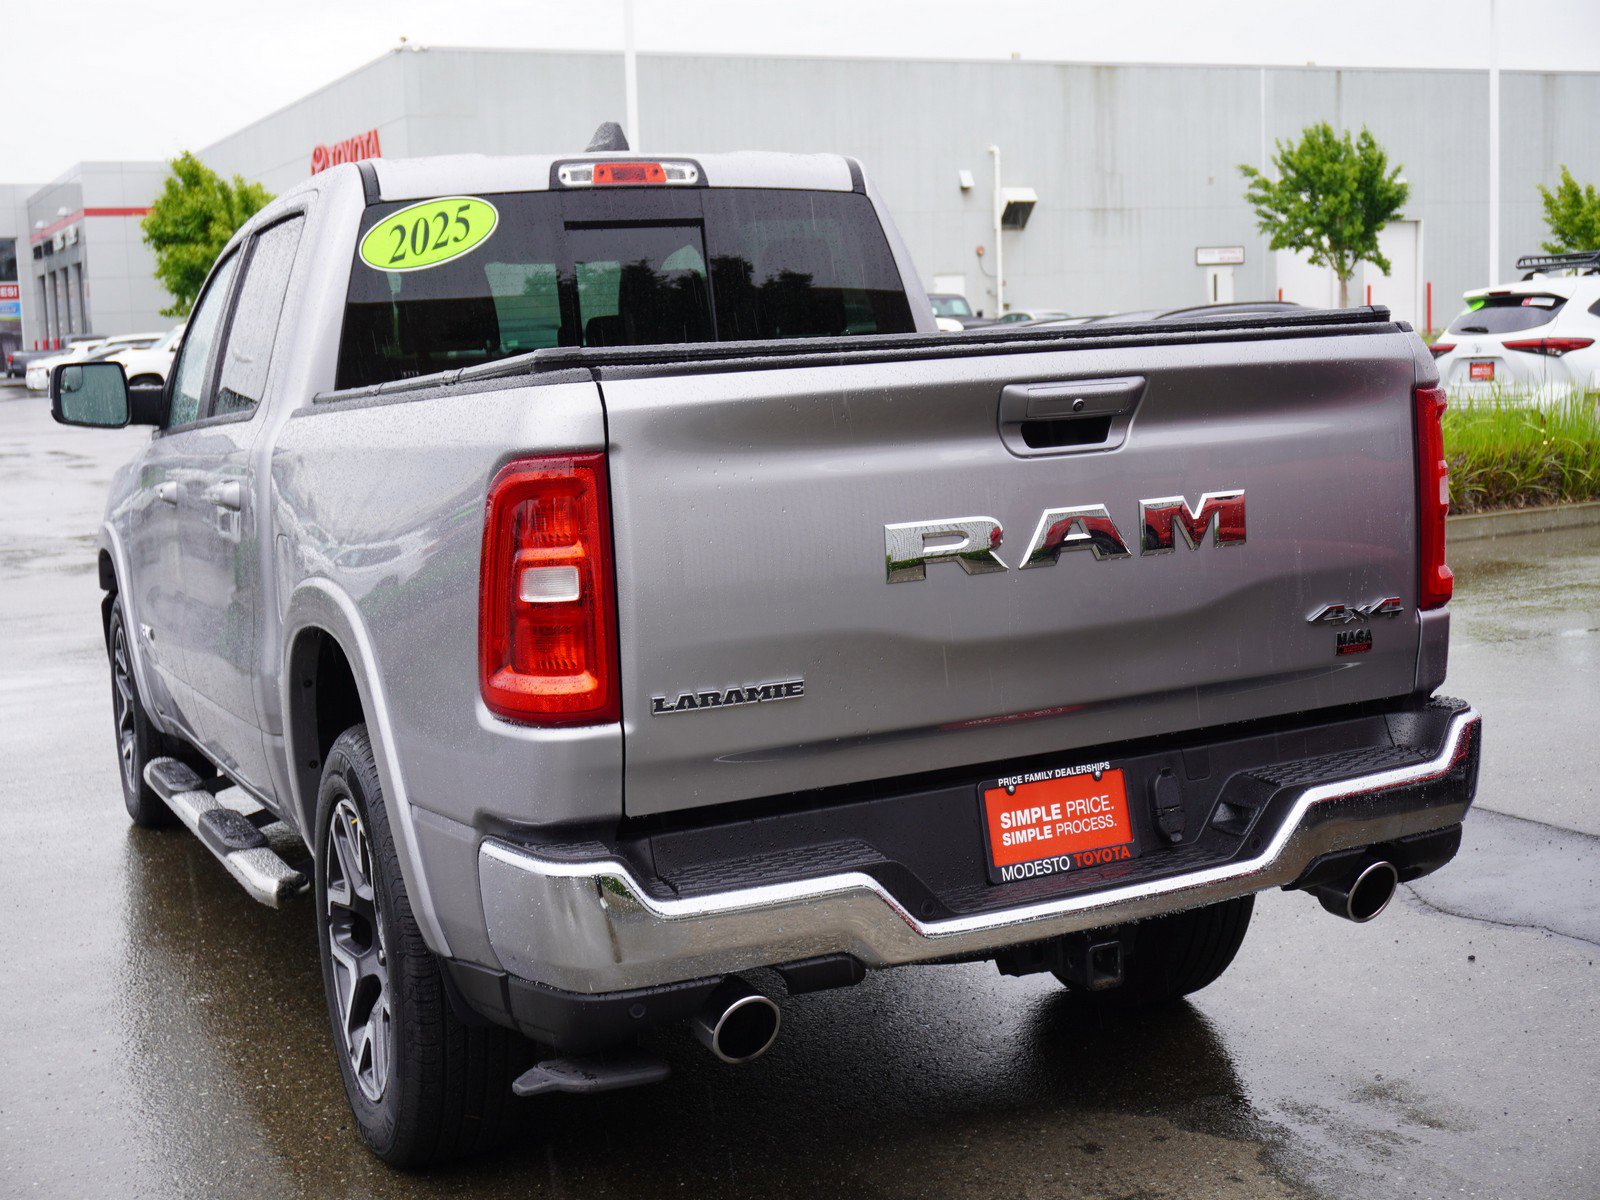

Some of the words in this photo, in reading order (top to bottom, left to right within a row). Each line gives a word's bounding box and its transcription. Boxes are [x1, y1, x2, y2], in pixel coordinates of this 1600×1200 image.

[331, 127, 382, 167] TOYOTA
[388, 204, 471, 265] 2025
[885, 489, 1246, 584] RAM
[1335, 628, 1373, 648] MAGA
[651, 679, 804, 716] LARAMIE
[998, 775, 1023, 787] PRICE
[1024, 770, 1053, 783] FAMILY
[1055, 761, 1110, 778] DEALERSHIPS
[1000, 803, 1062, 829] SIMPLE
[1065, 795, 1115, 817] PRICE.
[1002, 826, 1052, 846] SIMPLE
[1055, 814, 1117, 837] PROCESS.
[1001, 856, 1070, 882] MODESTO
[1074, 845, 1131, 868] TOYOTA
